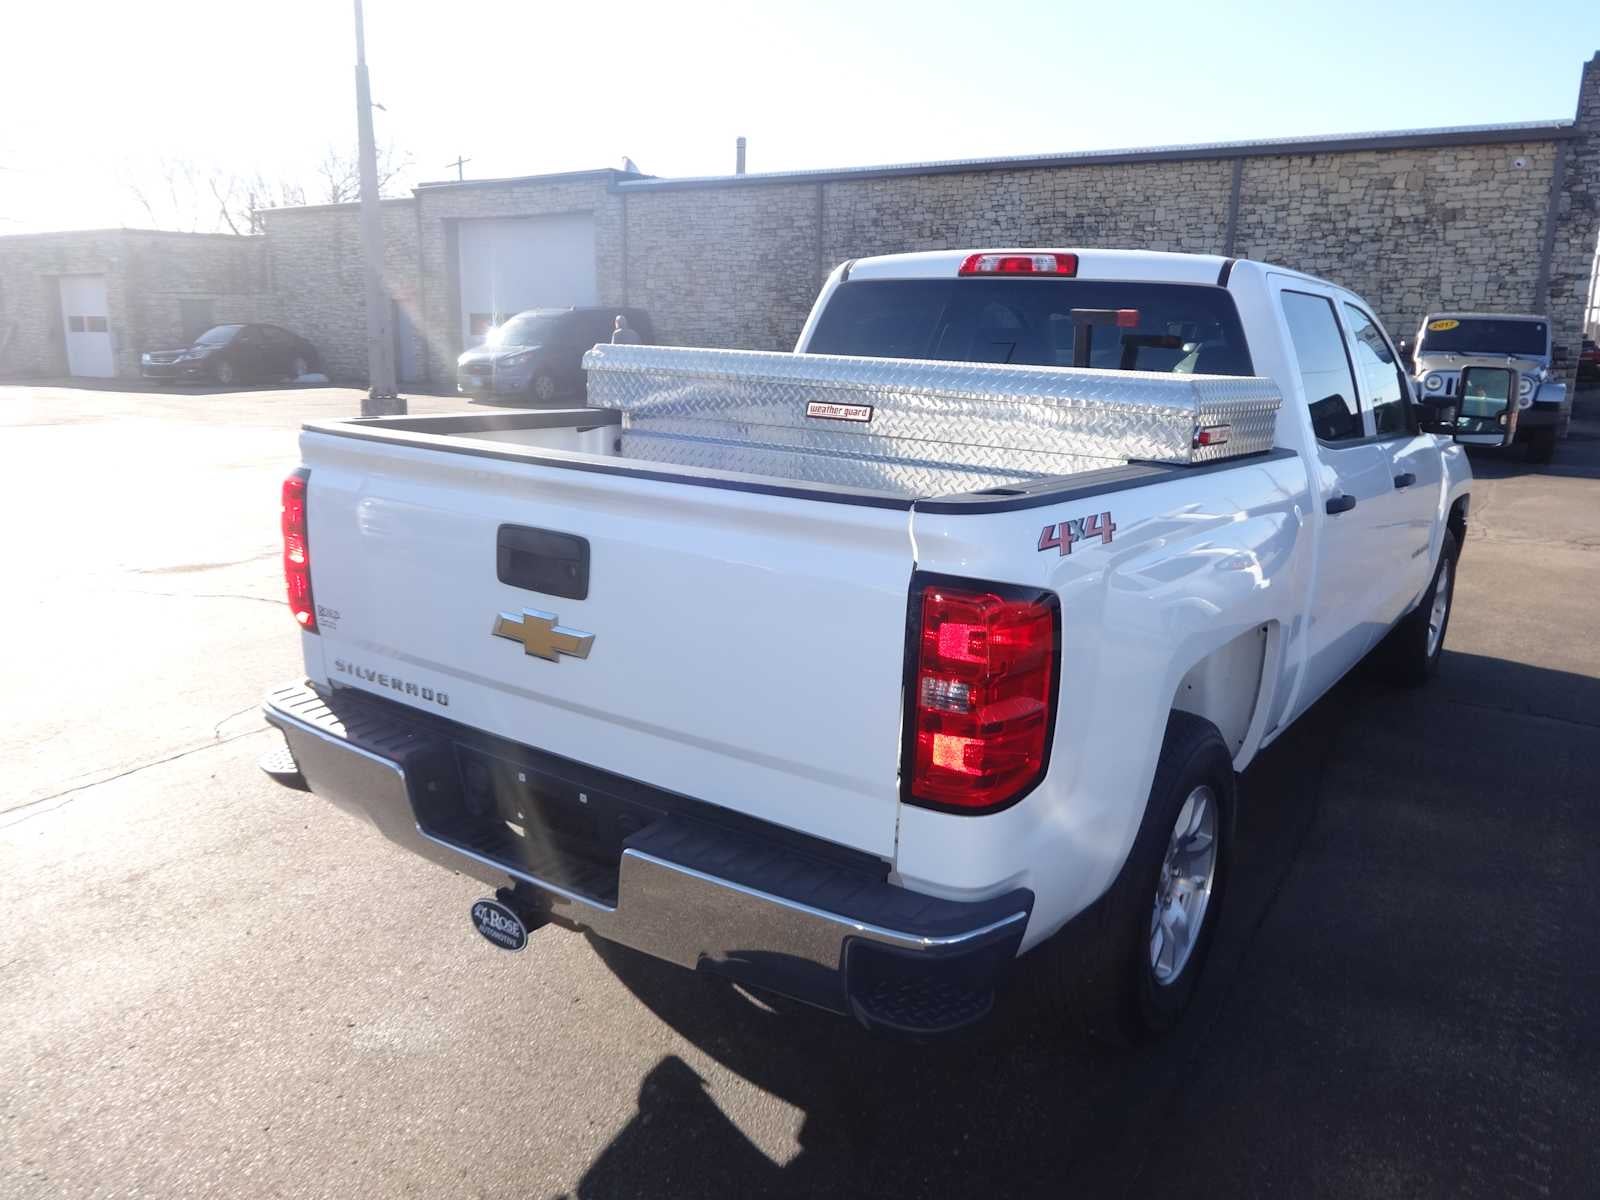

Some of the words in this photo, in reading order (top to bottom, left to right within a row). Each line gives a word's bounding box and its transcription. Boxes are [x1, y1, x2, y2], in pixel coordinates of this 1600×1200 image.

[809, 404, 842, 415] weather
[844, 407, 868, 417] guard
[335, 659, 449, 706] SILVERADO
